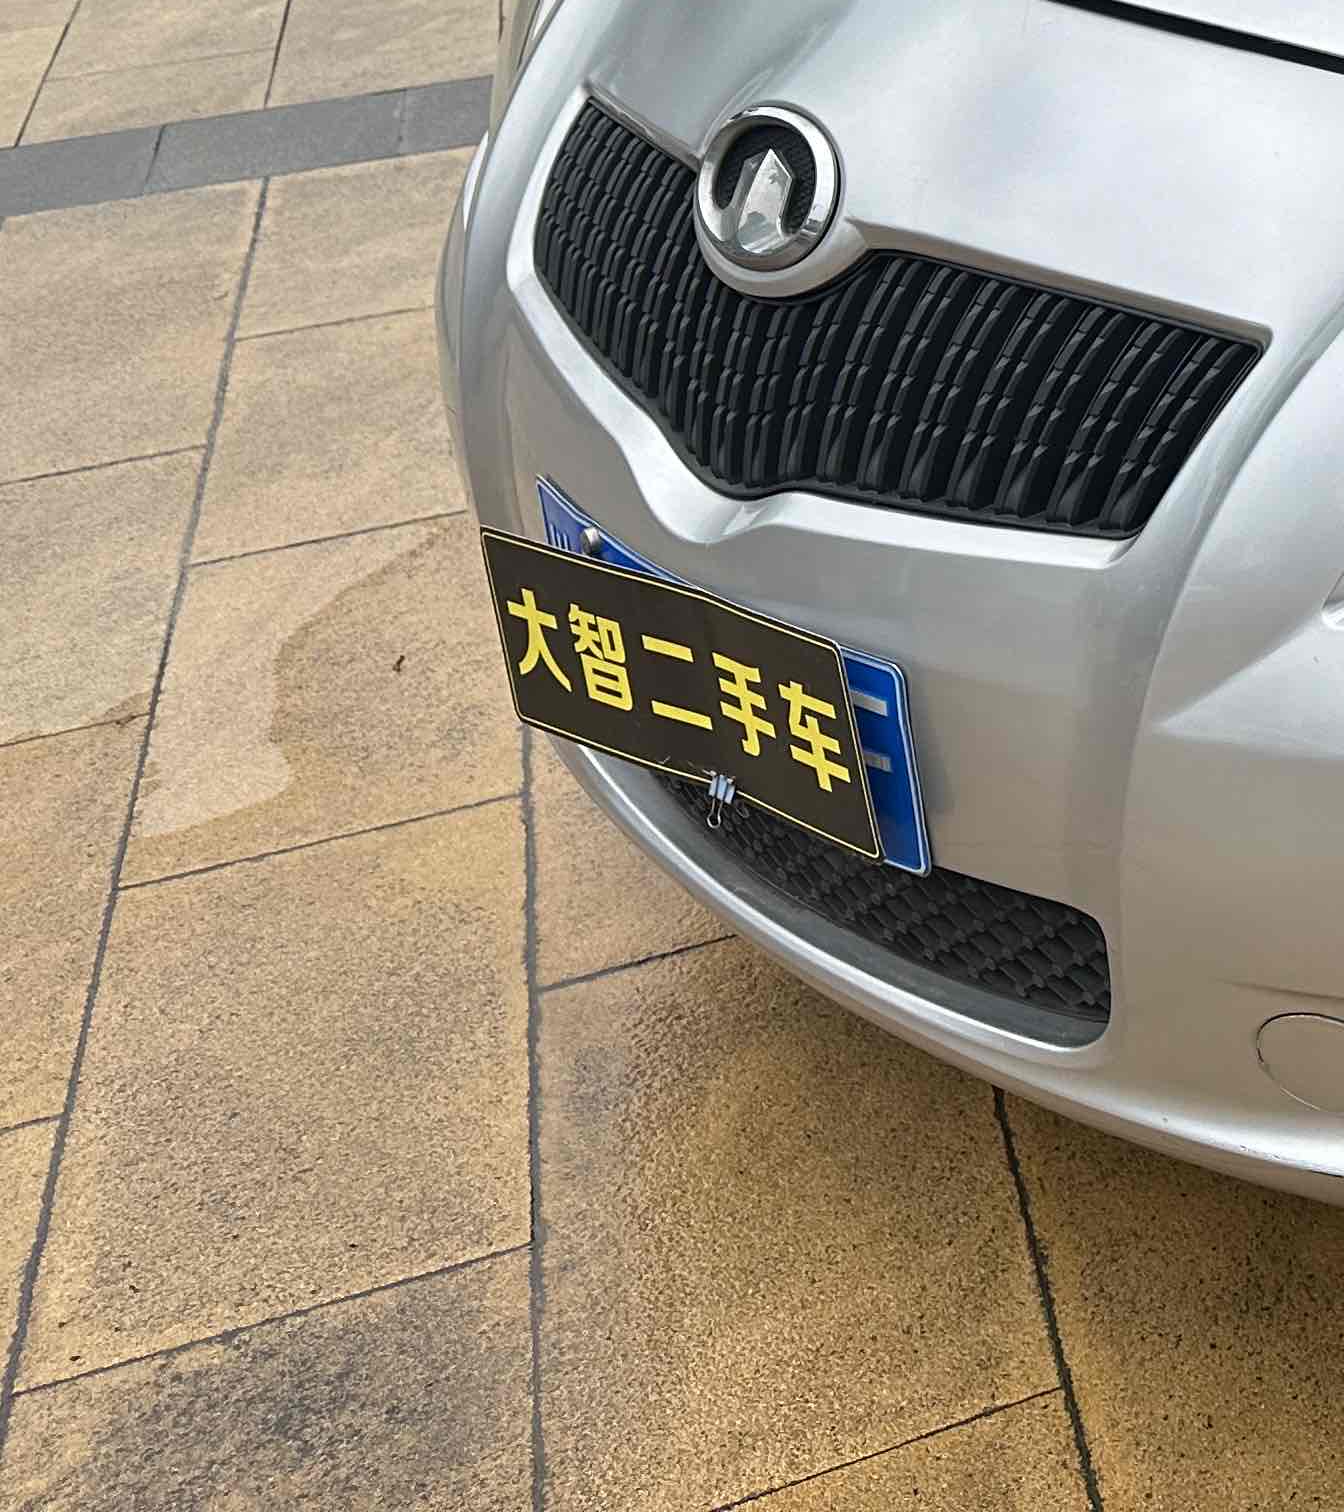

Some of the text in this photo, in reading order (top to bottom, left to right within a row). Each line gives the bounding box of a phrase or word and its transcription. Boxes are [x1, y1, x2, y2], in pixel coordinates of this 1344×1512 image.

[506, 588, 851, 793] 大智二手车
